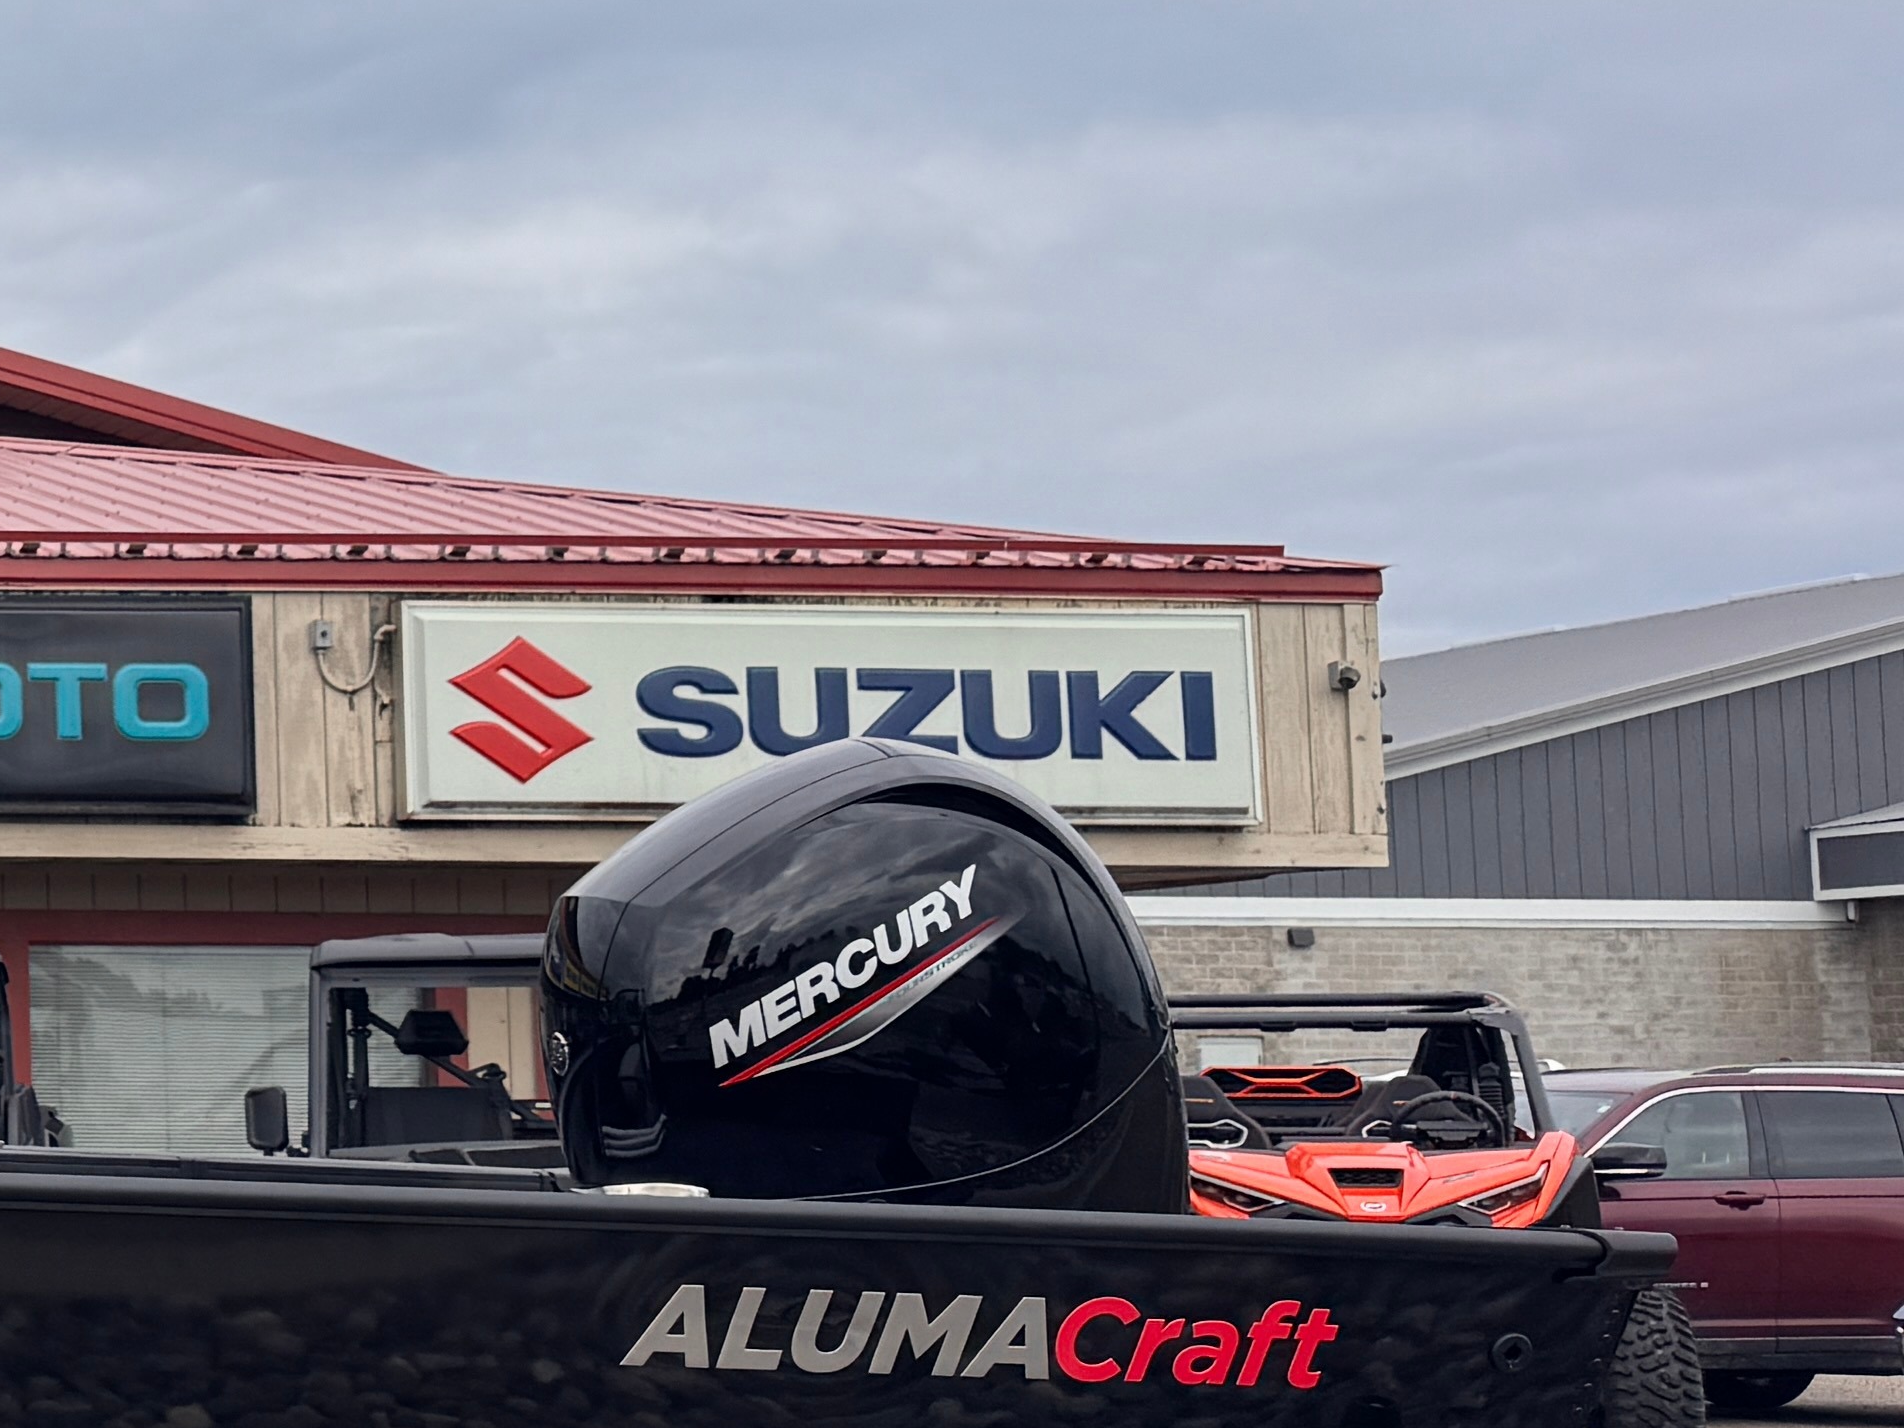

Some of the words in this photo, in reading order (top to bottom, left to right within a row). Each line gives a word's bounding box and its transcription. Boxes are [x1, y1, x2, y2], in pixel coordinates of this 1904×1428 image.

[636, 667, 1217, 761] SUZUKI
[709, 864, 976, 1068] MERCURY
[619, 1284, 1339, 1389] ALUMACraft
